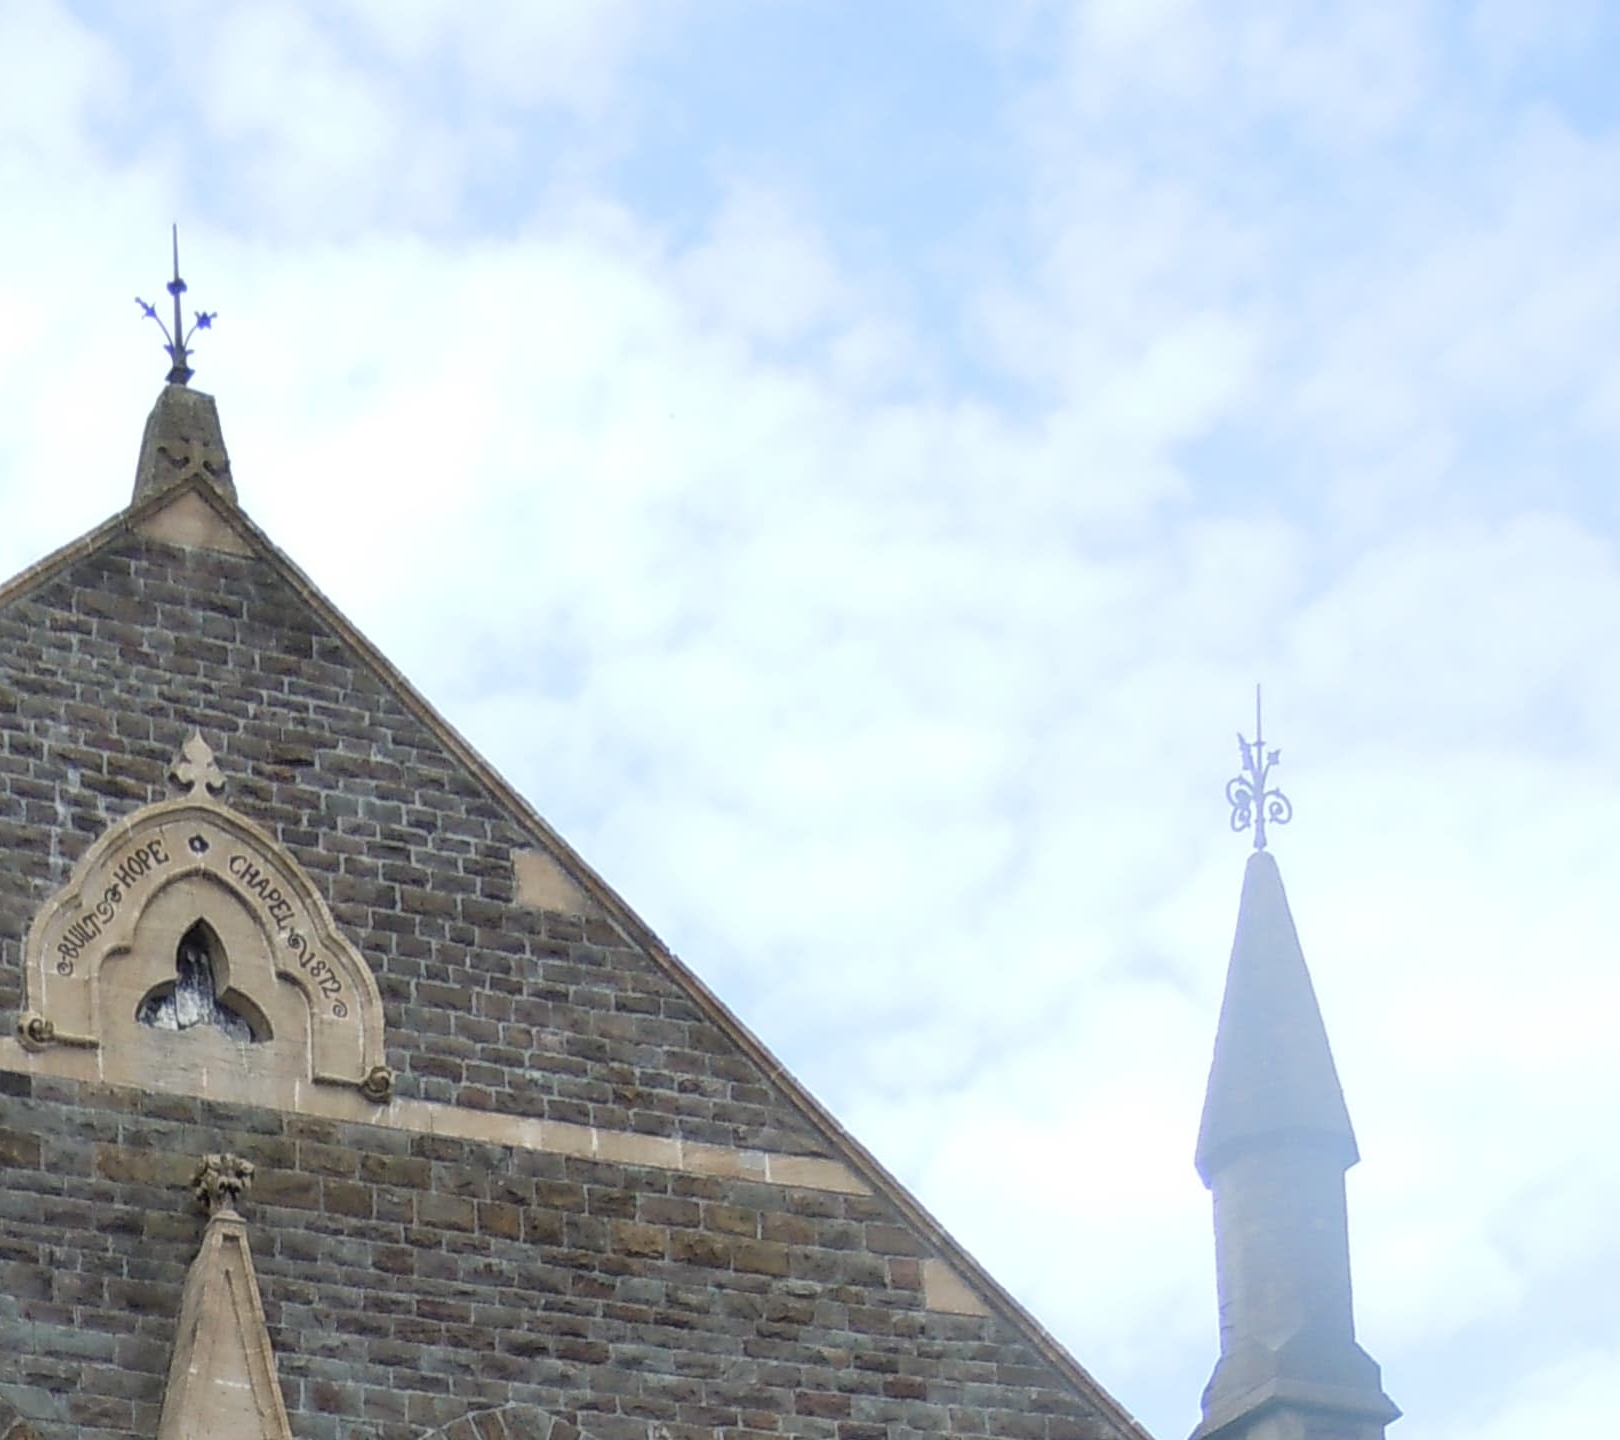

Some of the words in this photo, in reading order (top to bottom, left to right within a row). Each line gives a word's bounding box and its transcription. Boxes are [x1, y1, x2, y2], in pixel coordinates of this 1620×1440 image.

[60, 912, 102, 962] BUILT
[120, 839, 170, 889] HOPE
[228, 854, 295, 932] CHAPEL
[299, 951, 344, 999] 1872
